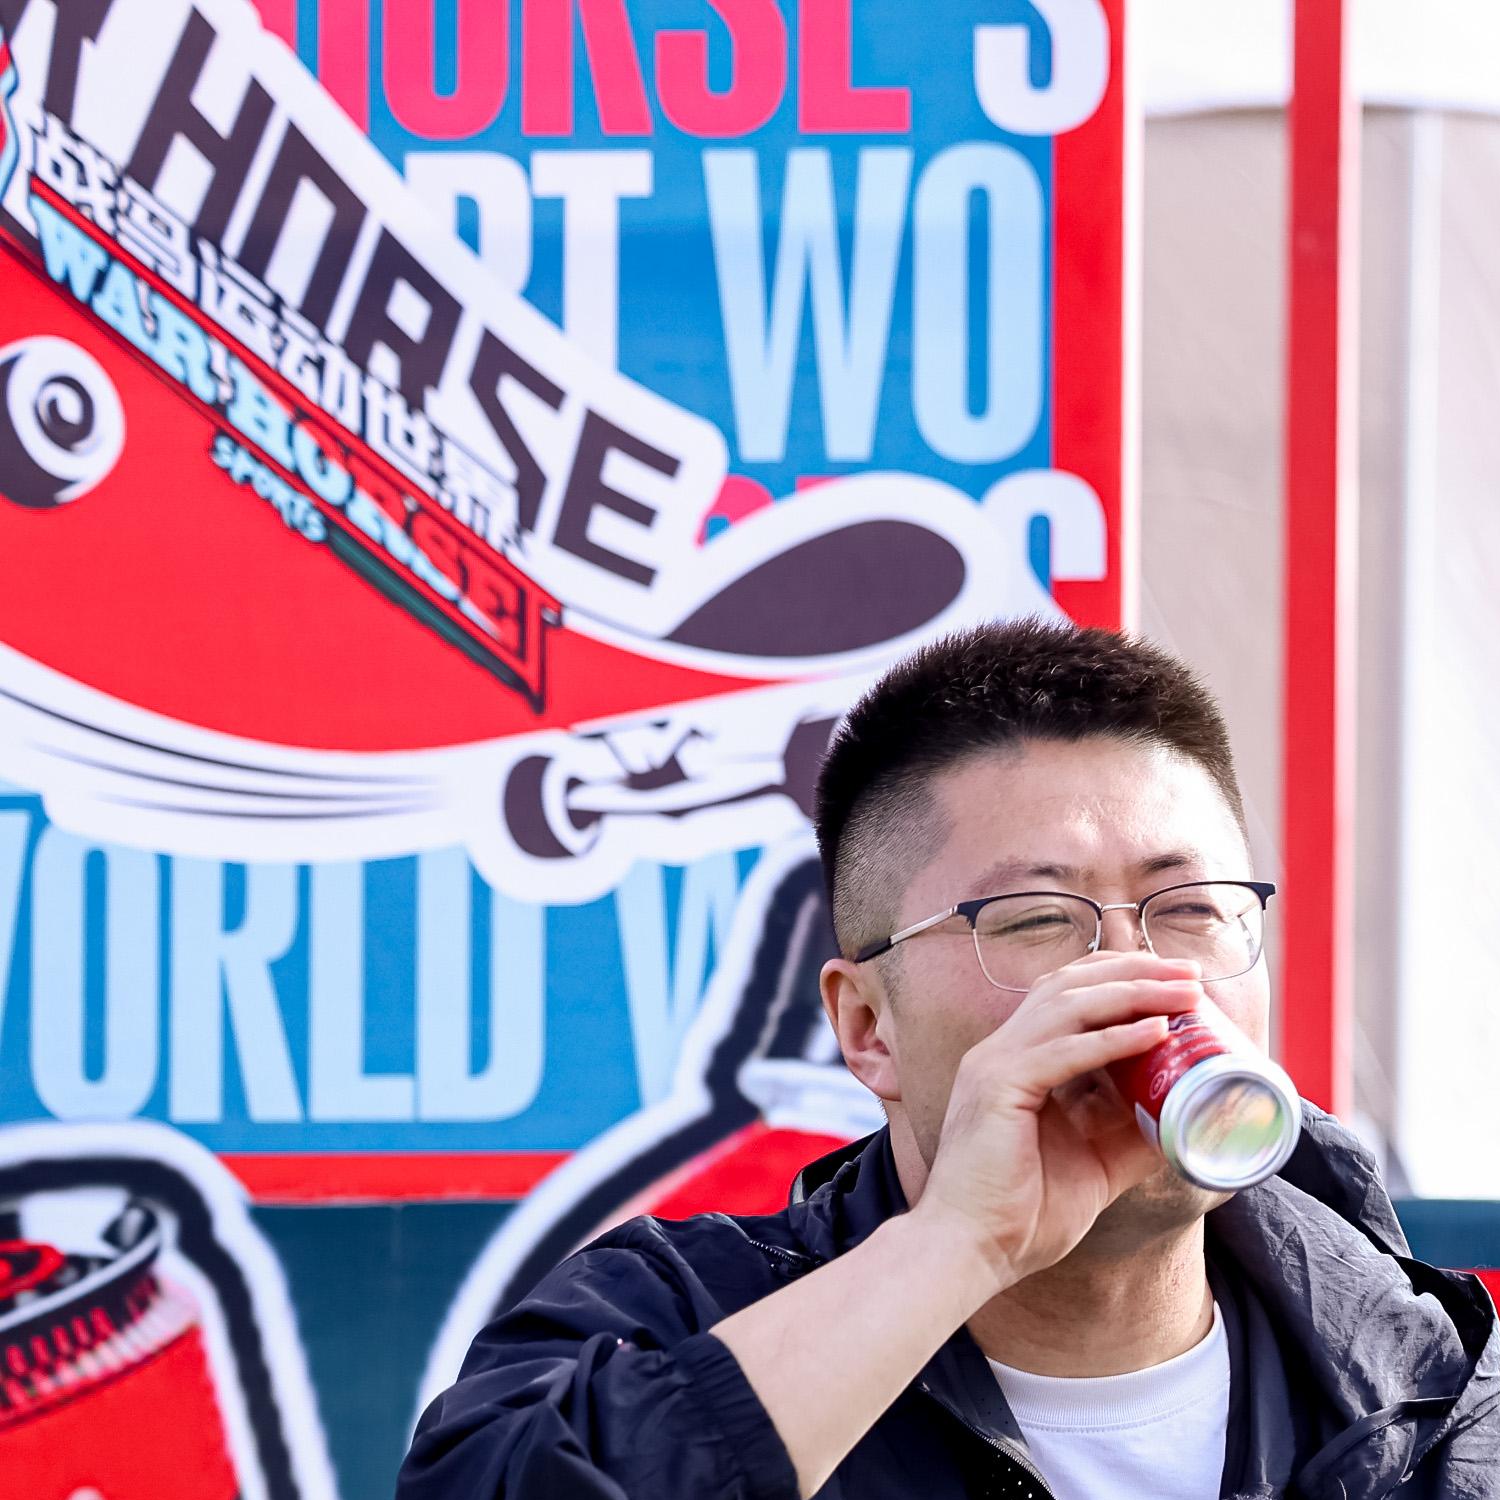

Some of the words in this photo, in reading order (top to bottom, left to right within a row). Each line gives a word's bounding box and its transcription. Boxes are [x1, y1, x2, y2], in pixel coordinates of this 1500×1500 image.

[28, 196, 228, 406] WAR
[122, 0, 682, 590] HORSE
[209, 432, 328, 546] SPORTS
